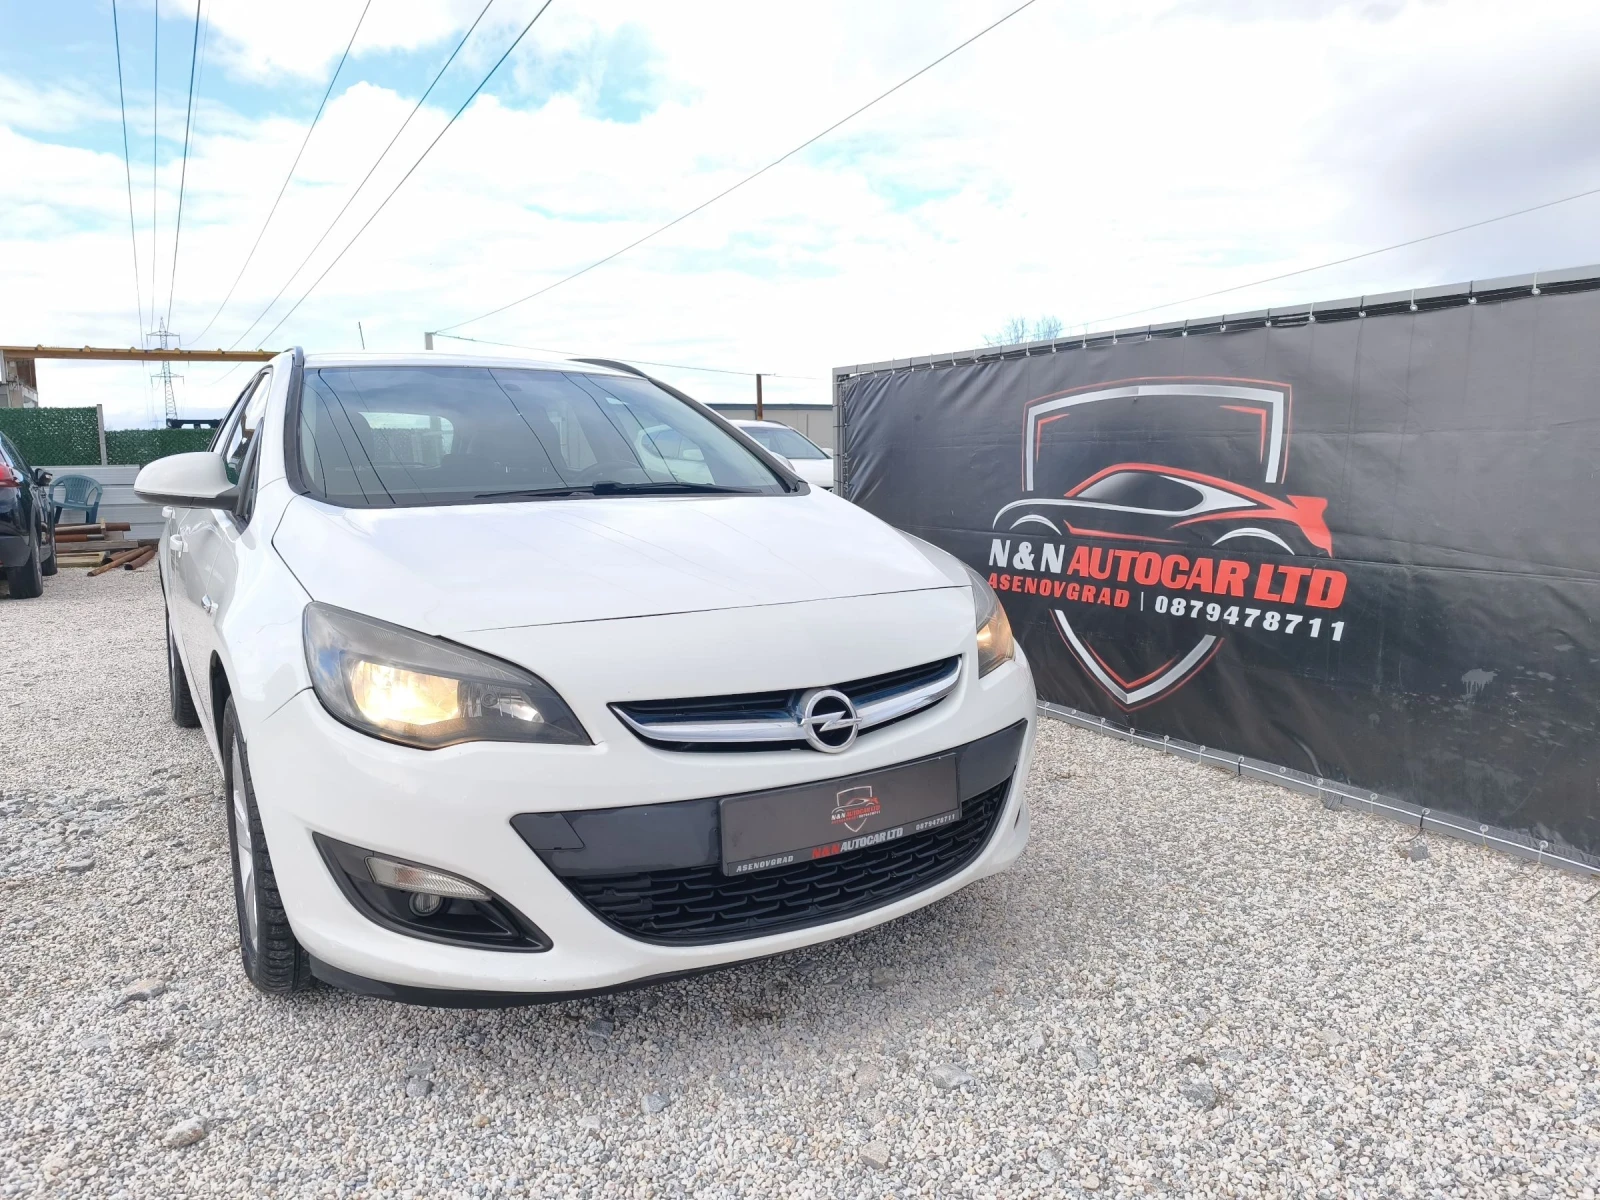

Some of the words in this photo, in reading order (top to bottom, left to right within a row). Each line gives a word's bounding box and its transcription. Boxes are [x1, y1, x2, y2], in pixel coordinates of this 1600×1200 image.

[988, 538, 1066, 574] N&N
[1066, 545, 1251, 598] AUTOCAR
[1253, 563, 1349, 610] LTD
[988, 572, 1131, 609] ASENOVGRAD
[1154, 595, 1345, 641] 0879478711
[915, 814, 955, 831] 0879478711
[840, 833, 886, 852] AUTOCAR
[886, 827, 903, 840] LTD
[736, 855, 794, 873] ASENOVGRAD
